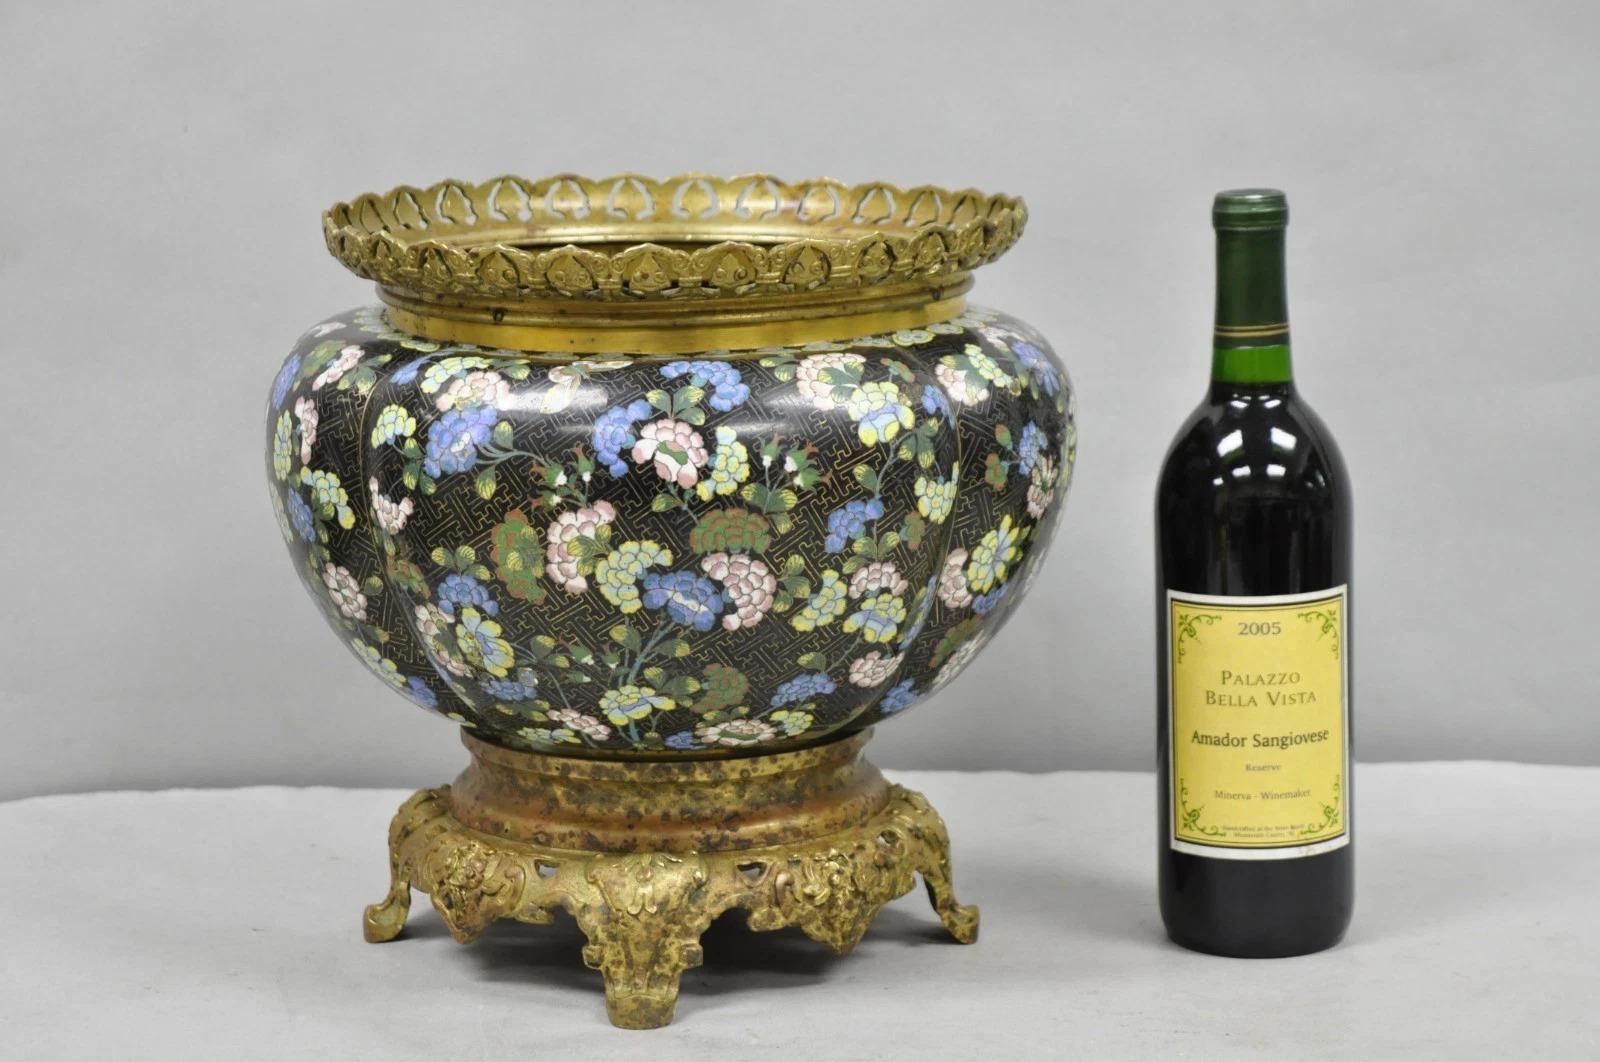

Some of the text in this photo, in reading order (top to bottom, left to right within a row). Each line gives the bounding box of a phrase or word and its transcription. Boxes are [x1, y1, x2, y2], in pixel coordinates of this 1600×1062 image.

[1238, 622, 1281, 635] 2005
[1221, 670, 1300, 686] PALAZZO
[1206, 690, 1317, 707] BELLA VISTA
[1191, 729, 1329, 749] Amador Sangiovese
[1245, 763, 1282, 772] Reserve
[1214, 790, 1251, 800] Minerva
[1261, 789, 1311, 800] Winemaker
